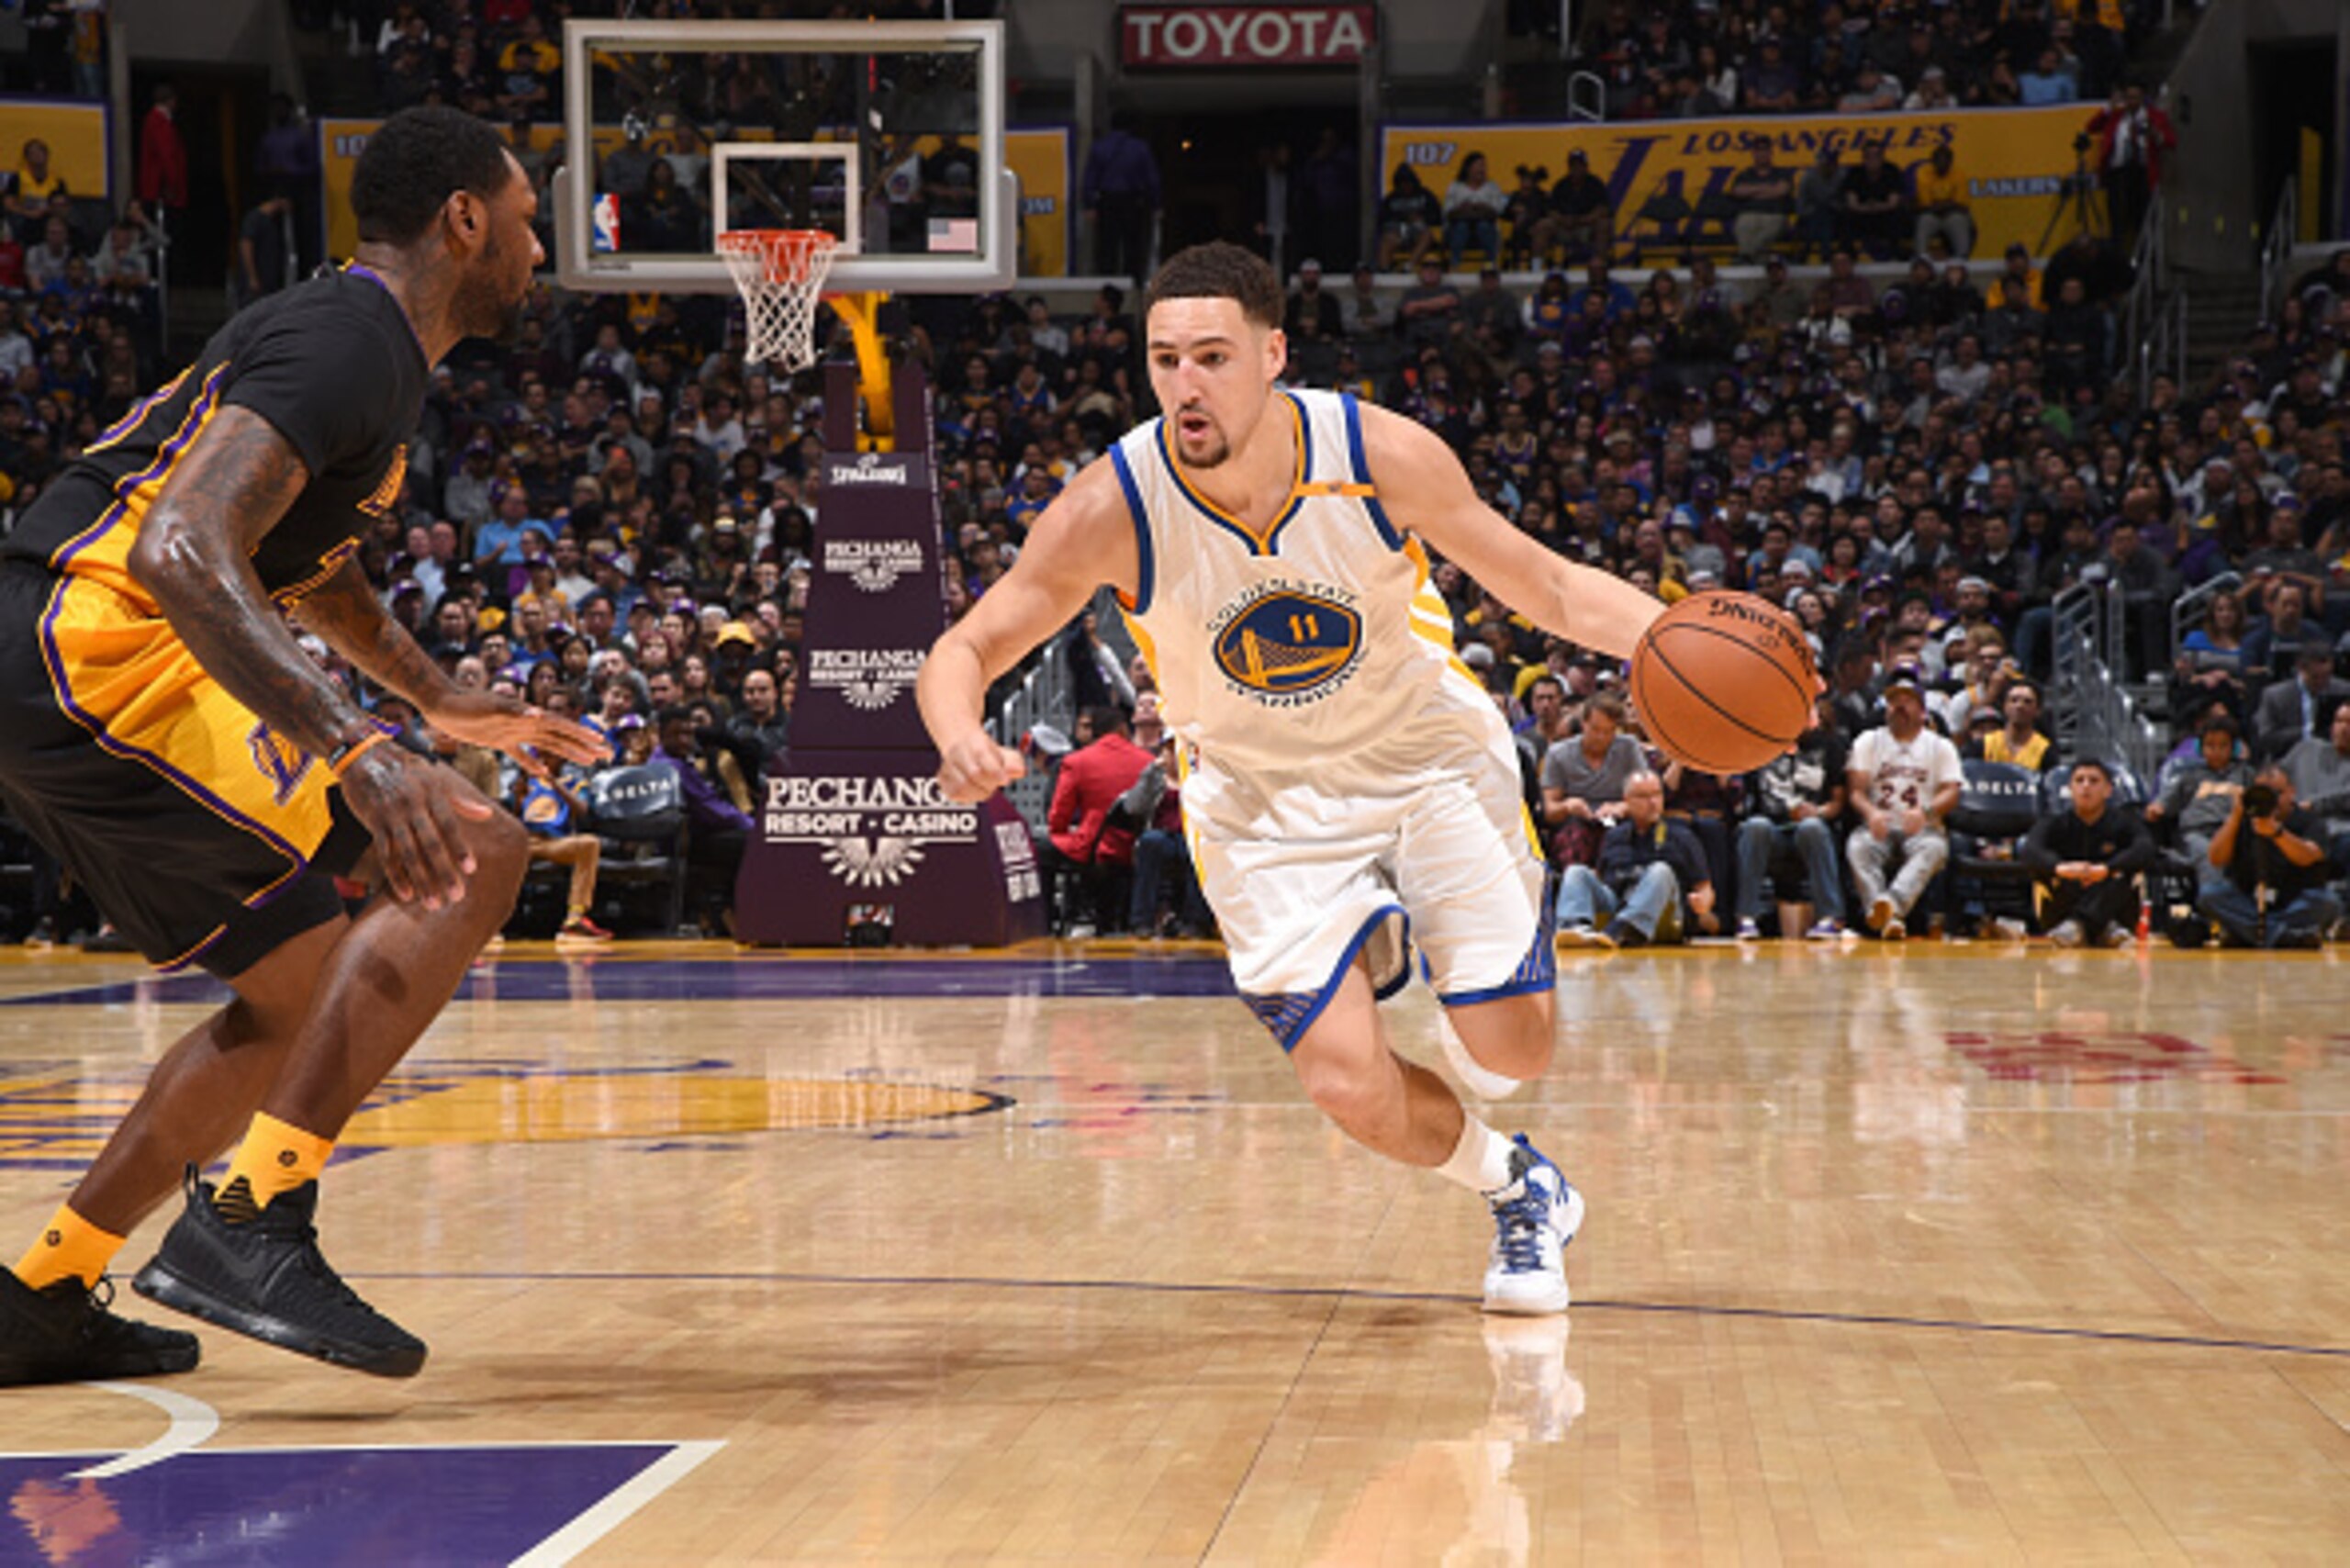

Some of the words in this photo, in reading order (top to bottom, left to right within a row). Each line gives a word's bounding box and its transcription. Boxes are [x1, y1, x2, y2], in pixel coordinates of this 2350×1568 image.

[1126, 13, 1366, 57] TOYOTA
[1405, 142, 1457, 165] 107
[1289, 613, 1320, 643] 11
[766, 778, 947, 808] PECHANG
[1877, 785, 1919, 809] 24
[1975, 780, 2038, 796] DELTA
[766, 813, 863, 834] RESORT
[883, 813, 977, 834] CASINO
